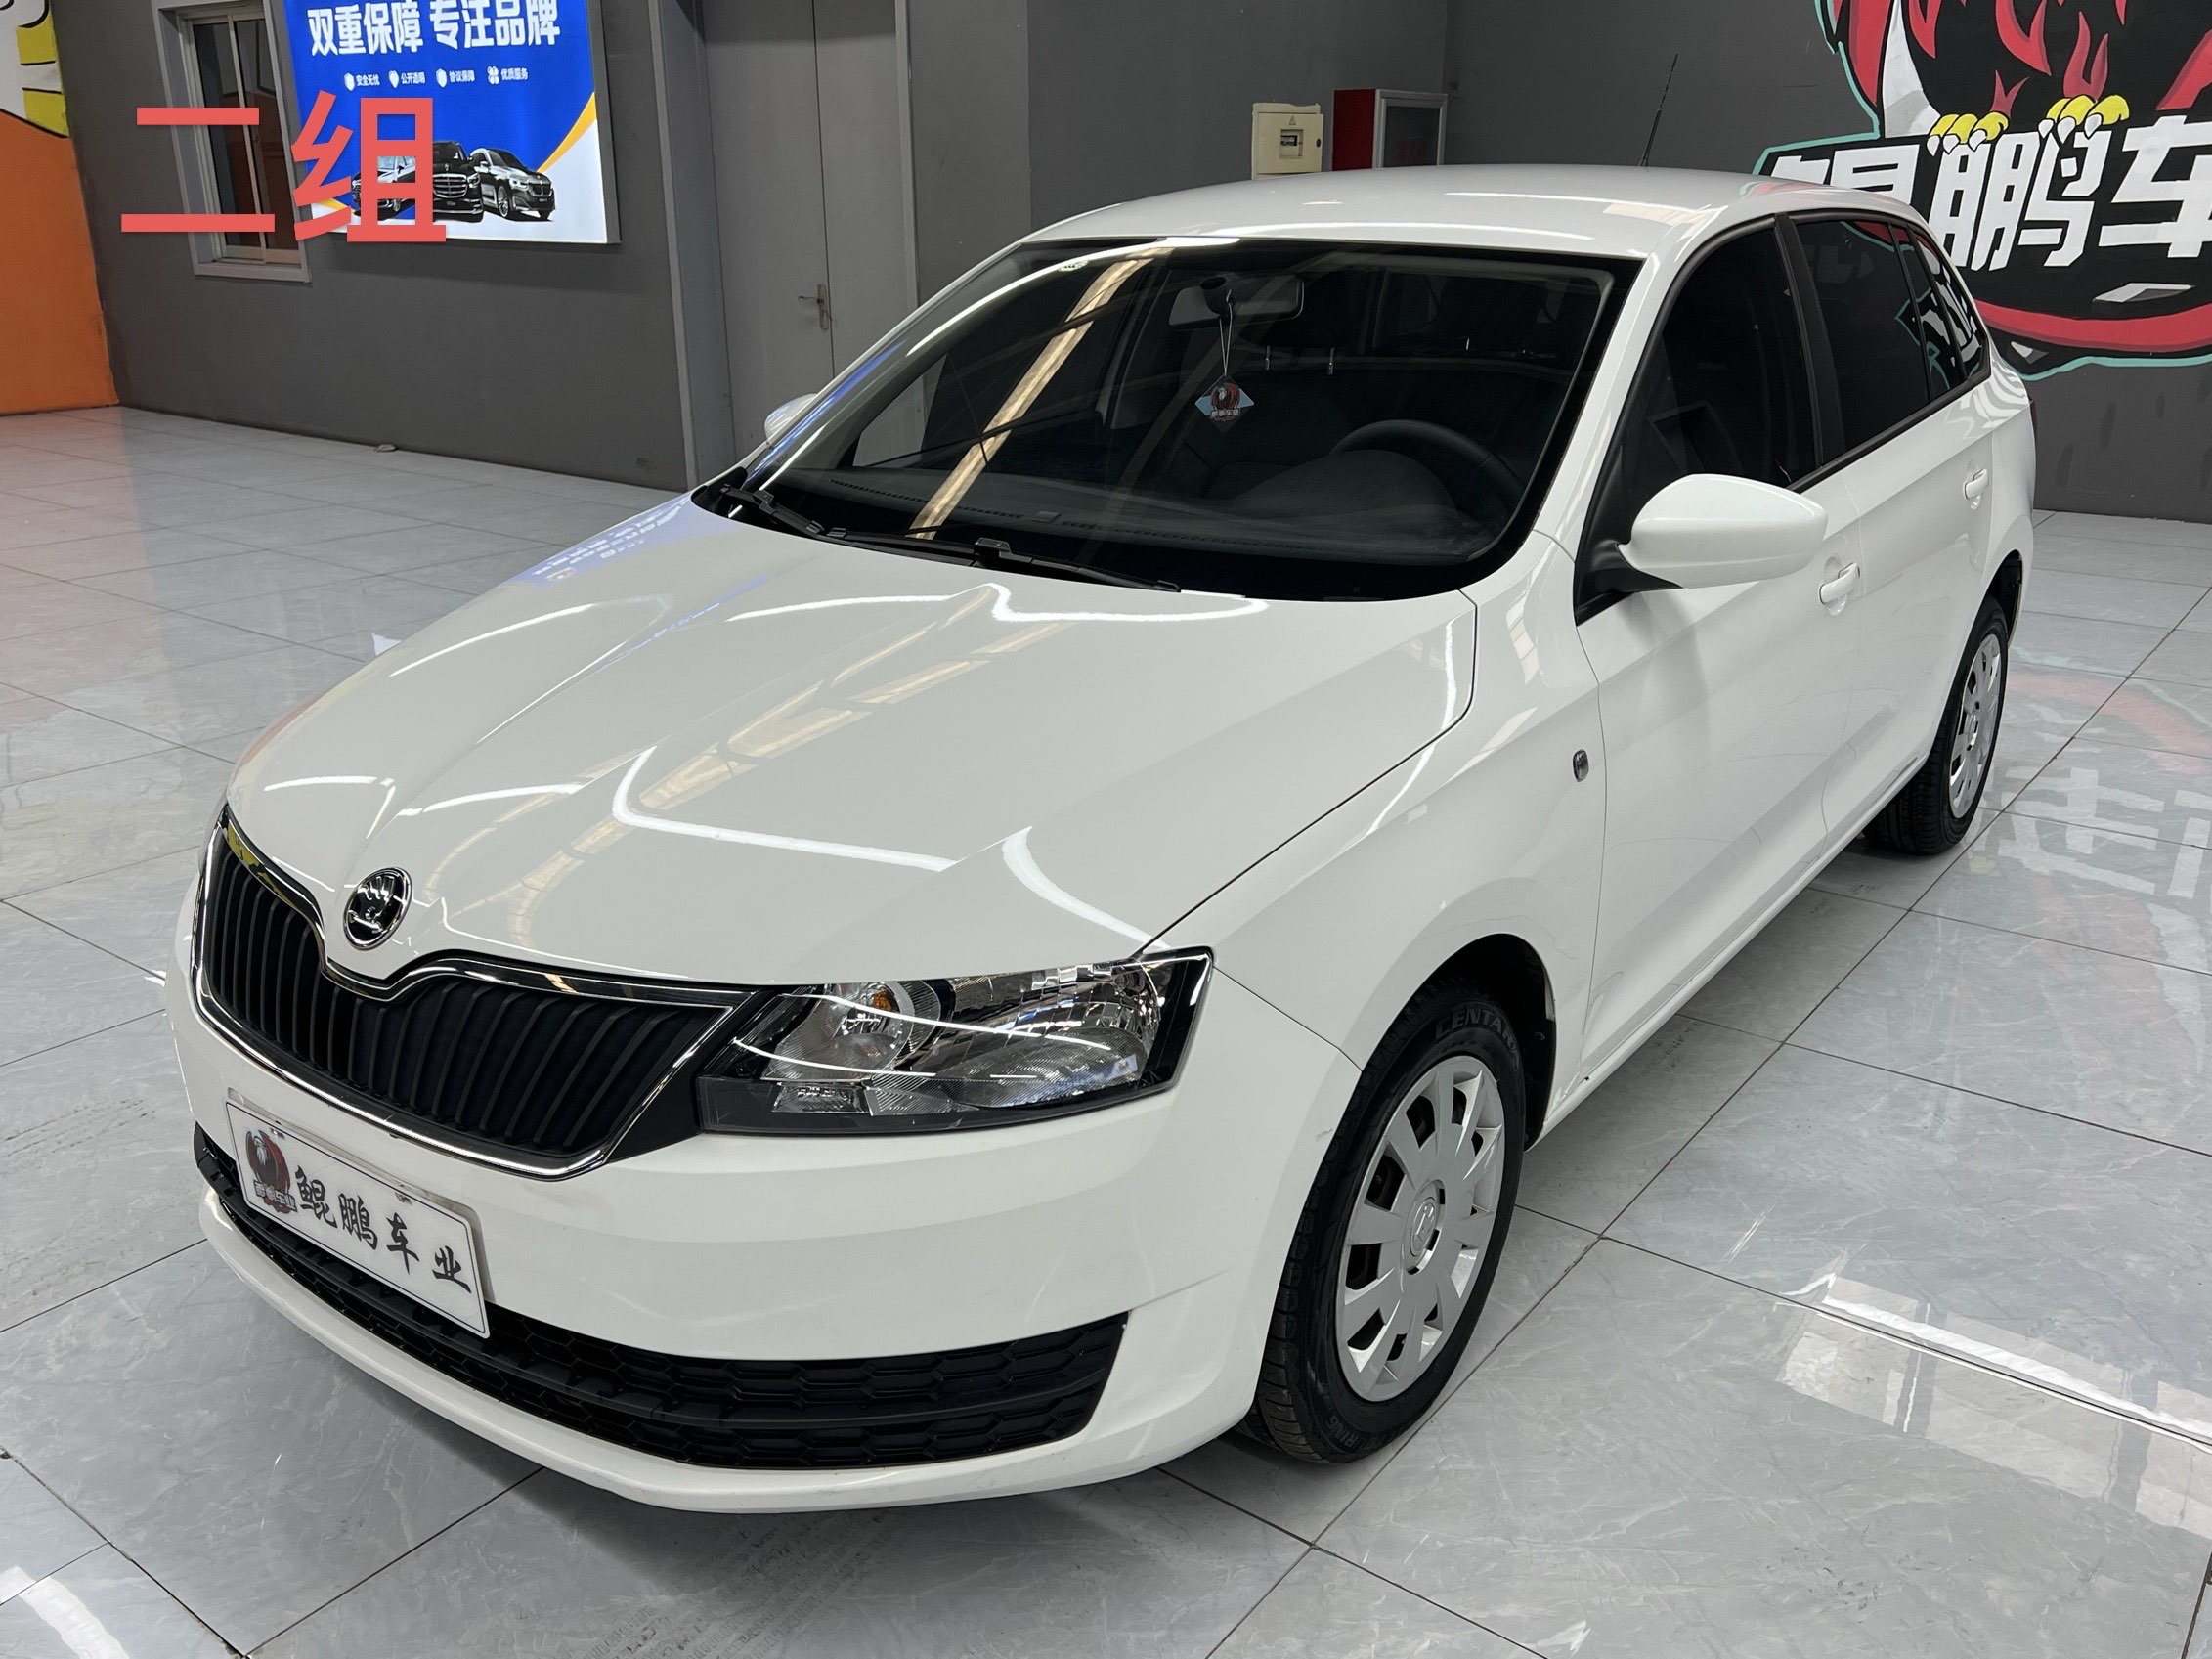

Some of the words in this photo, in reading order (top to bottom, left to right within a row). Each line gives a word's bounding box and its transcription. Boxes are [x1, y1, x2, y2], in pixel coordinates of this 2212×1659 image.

[307, 0, 423, 56] 双重保障
[430, 0, 560, 49] 专注品牌
[356, 74, 380, 86] 安全无忧
[449, 69, 475, 83] 协议保障
[500, 67, 528, 81] 优质服务
[295, 1165, 471, 1293] 鲲鹏车业
